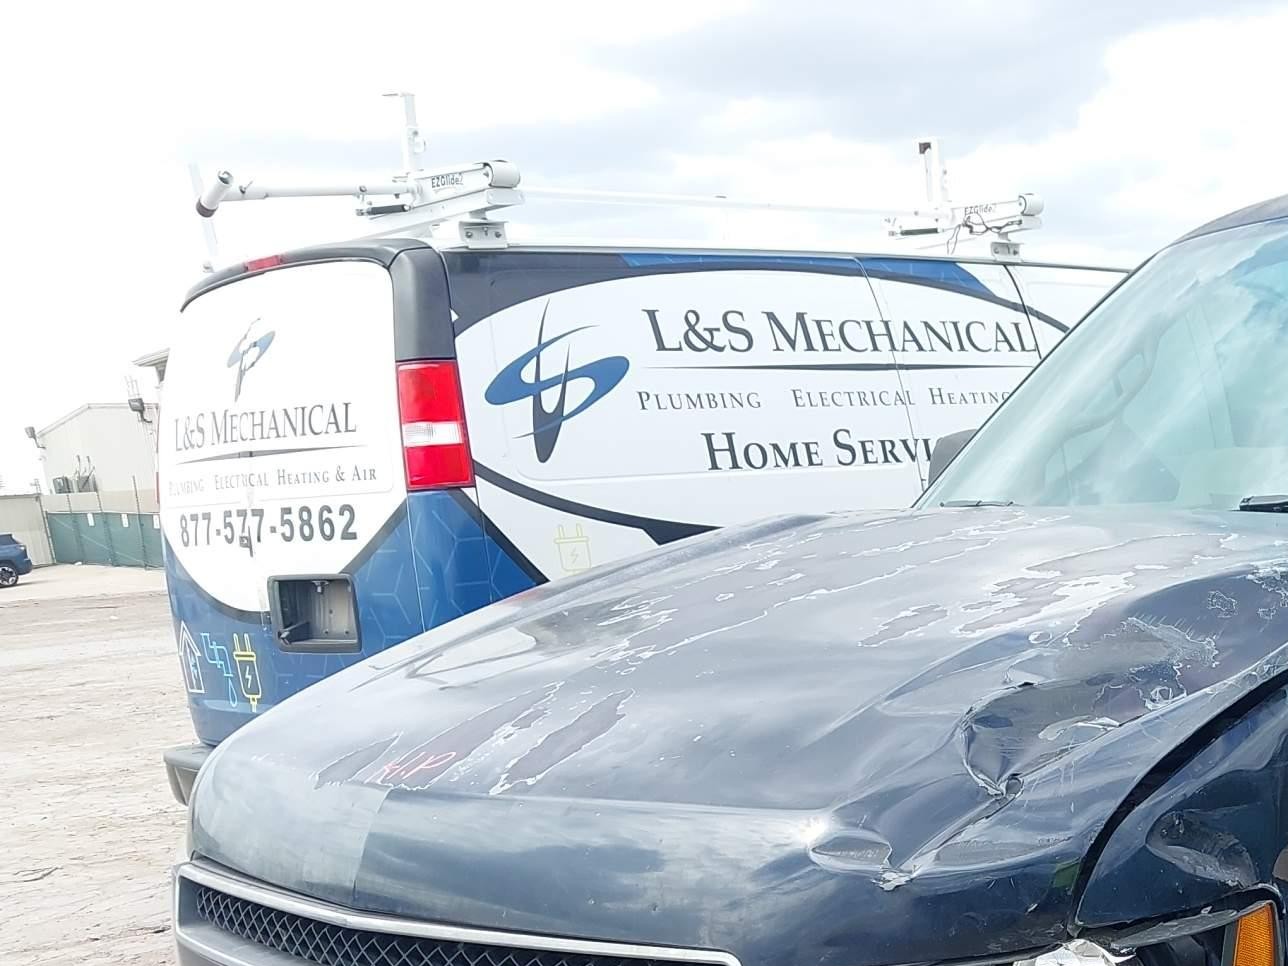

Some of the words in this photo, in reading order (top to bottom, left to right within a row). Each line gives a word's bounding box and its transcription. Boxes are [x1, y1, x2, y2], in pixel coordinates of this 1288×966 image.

[641, 309, 754, 353] L&S
[761, 311, 1036, 353] MECHANICAL
[636, 390, 761, 411] PLUMBING
[791, 388, 916, 408] ELECTRICAL
[174, 413, 205, 452] L&S
[211, 402, 357, 446] MECHANICAL
[700, 432, 823, 471] HOME
[214, 472, 269, 490] ELECTRICAL
[277, 468, 329, 486] HEATING
[335, 464, 345, 482] &
[352, 464, 377, 481] AIR
[179, 503, 358, 548] 877-577-5862
